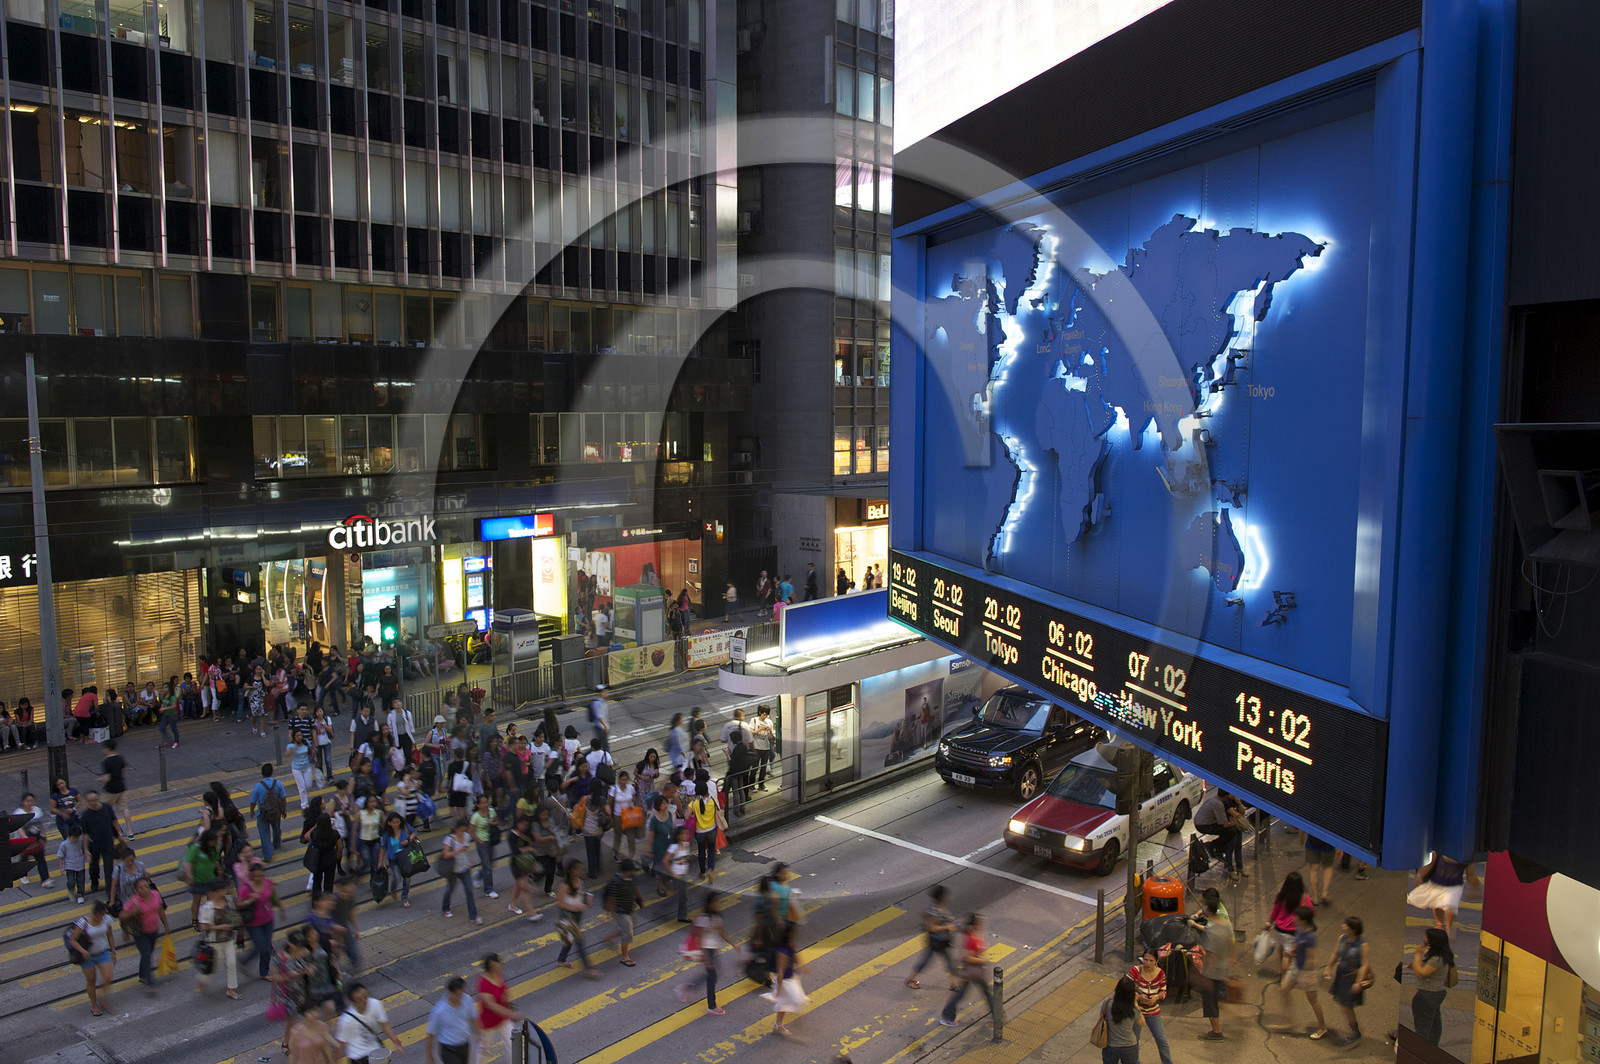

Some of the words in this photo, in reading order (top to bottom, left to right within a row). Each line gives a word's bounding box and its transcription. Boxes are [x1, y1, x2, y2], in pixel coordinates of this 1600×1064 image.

[1143, 401, 1163, 414] Hong
[1164, 400, 1183, 414] Kong
[1247, 384, 1275, 400] Tokyo
[328, 514, 437, 550] citibank
[892, 562, 917, 588] 19:02
[1203, 556, 1233, 576] Sydney
[892, 589, 918, 621] Beijing
[933, 577, 963, 607] 20:02
[933, 608, 960, 637] Seoul
[984, 596, 1021, 630] 20:02
[984, 629, 1019, 665] Tokyo
[1048, 620, 1094, 660] 06:02
[1041, 655, 1098, 703] Chicago
[1128, 651, 1187, 698] 07:02
[947, 689, 962, 702] Step
[1160, 707, 1204, 752] York
[1235, 691, 1312, 749] 13:02
[1236, 741, 1296, 795] Paris
